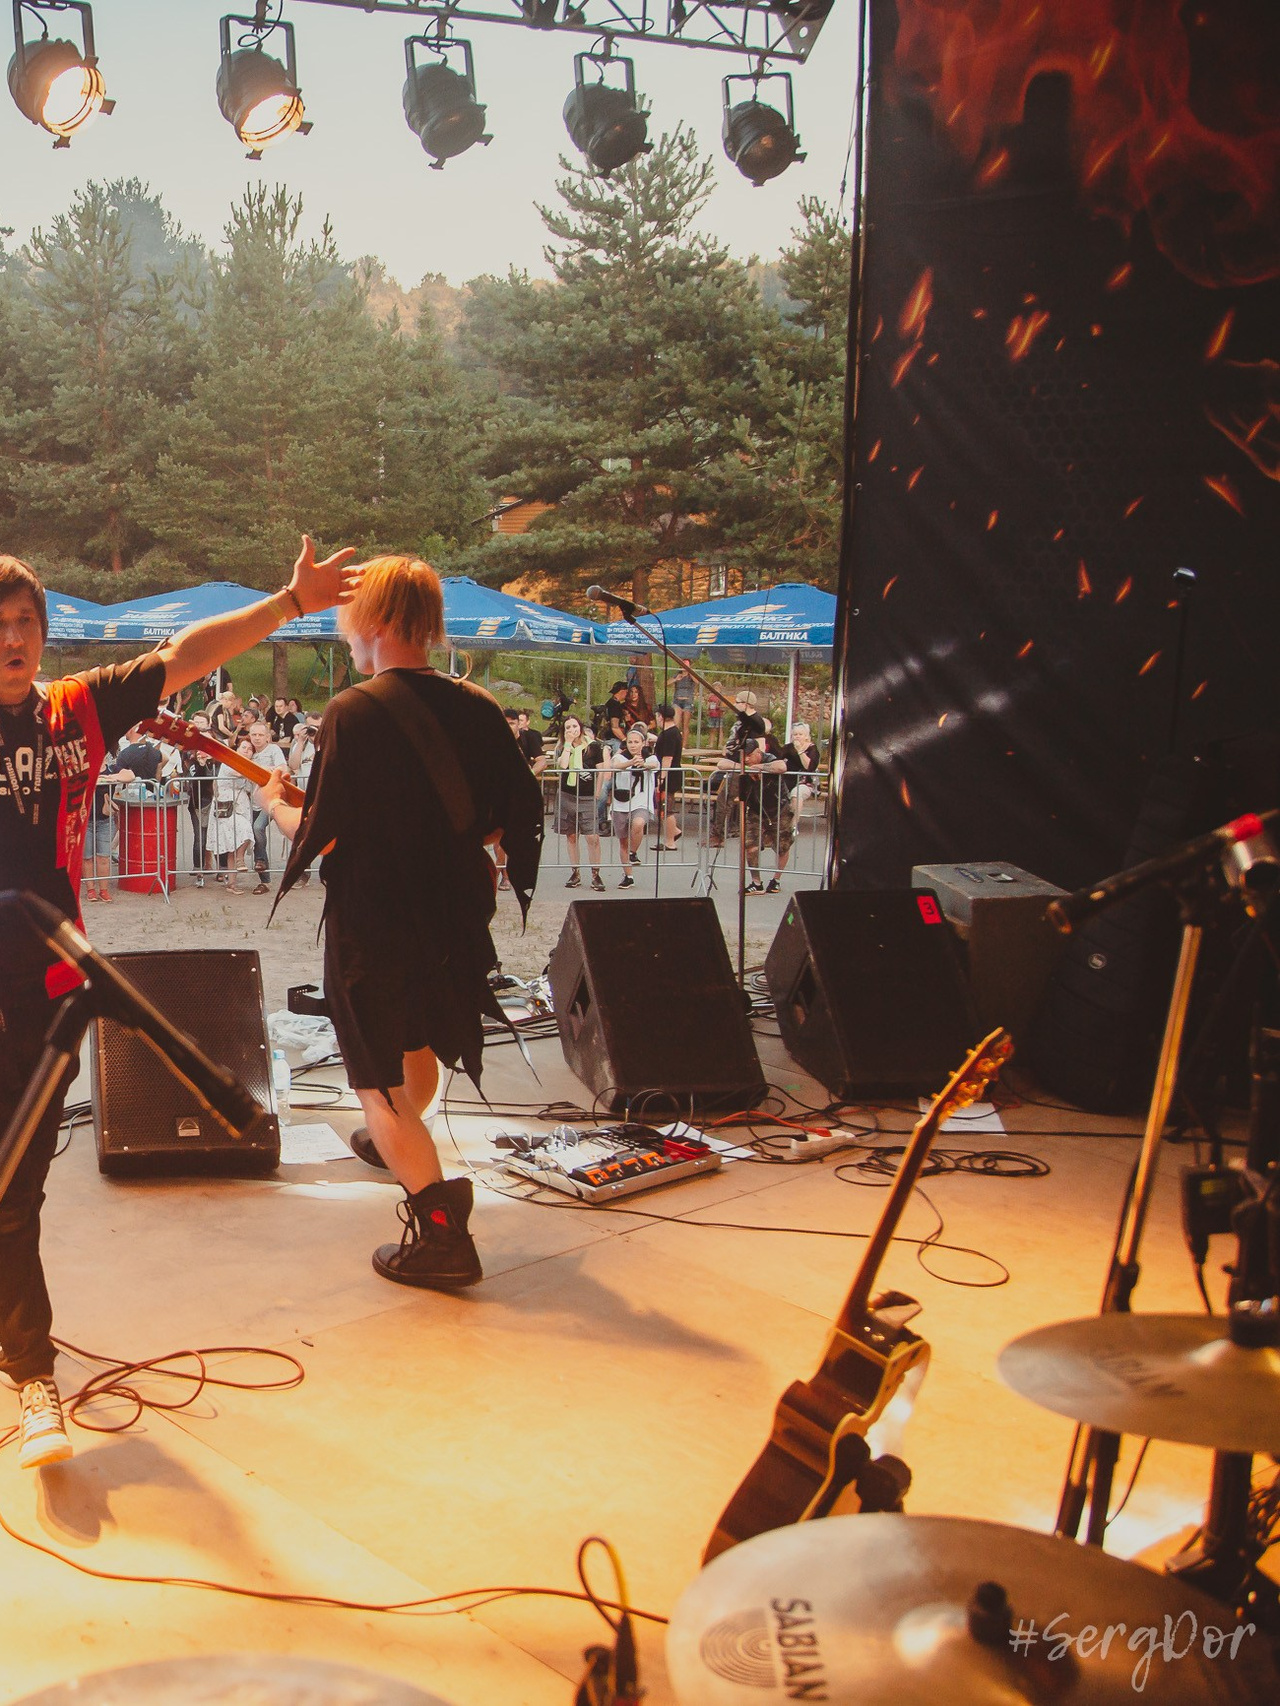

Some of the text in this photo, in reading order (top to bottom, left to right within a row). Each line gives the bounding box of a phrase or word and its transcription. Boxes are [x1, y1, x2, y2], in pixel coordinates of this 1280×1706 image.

[759, 631, 808, 640] БАЛТИКА
[923, 902, 934, 915] 3
[770, 1597, 829, 1700] SABIAN
